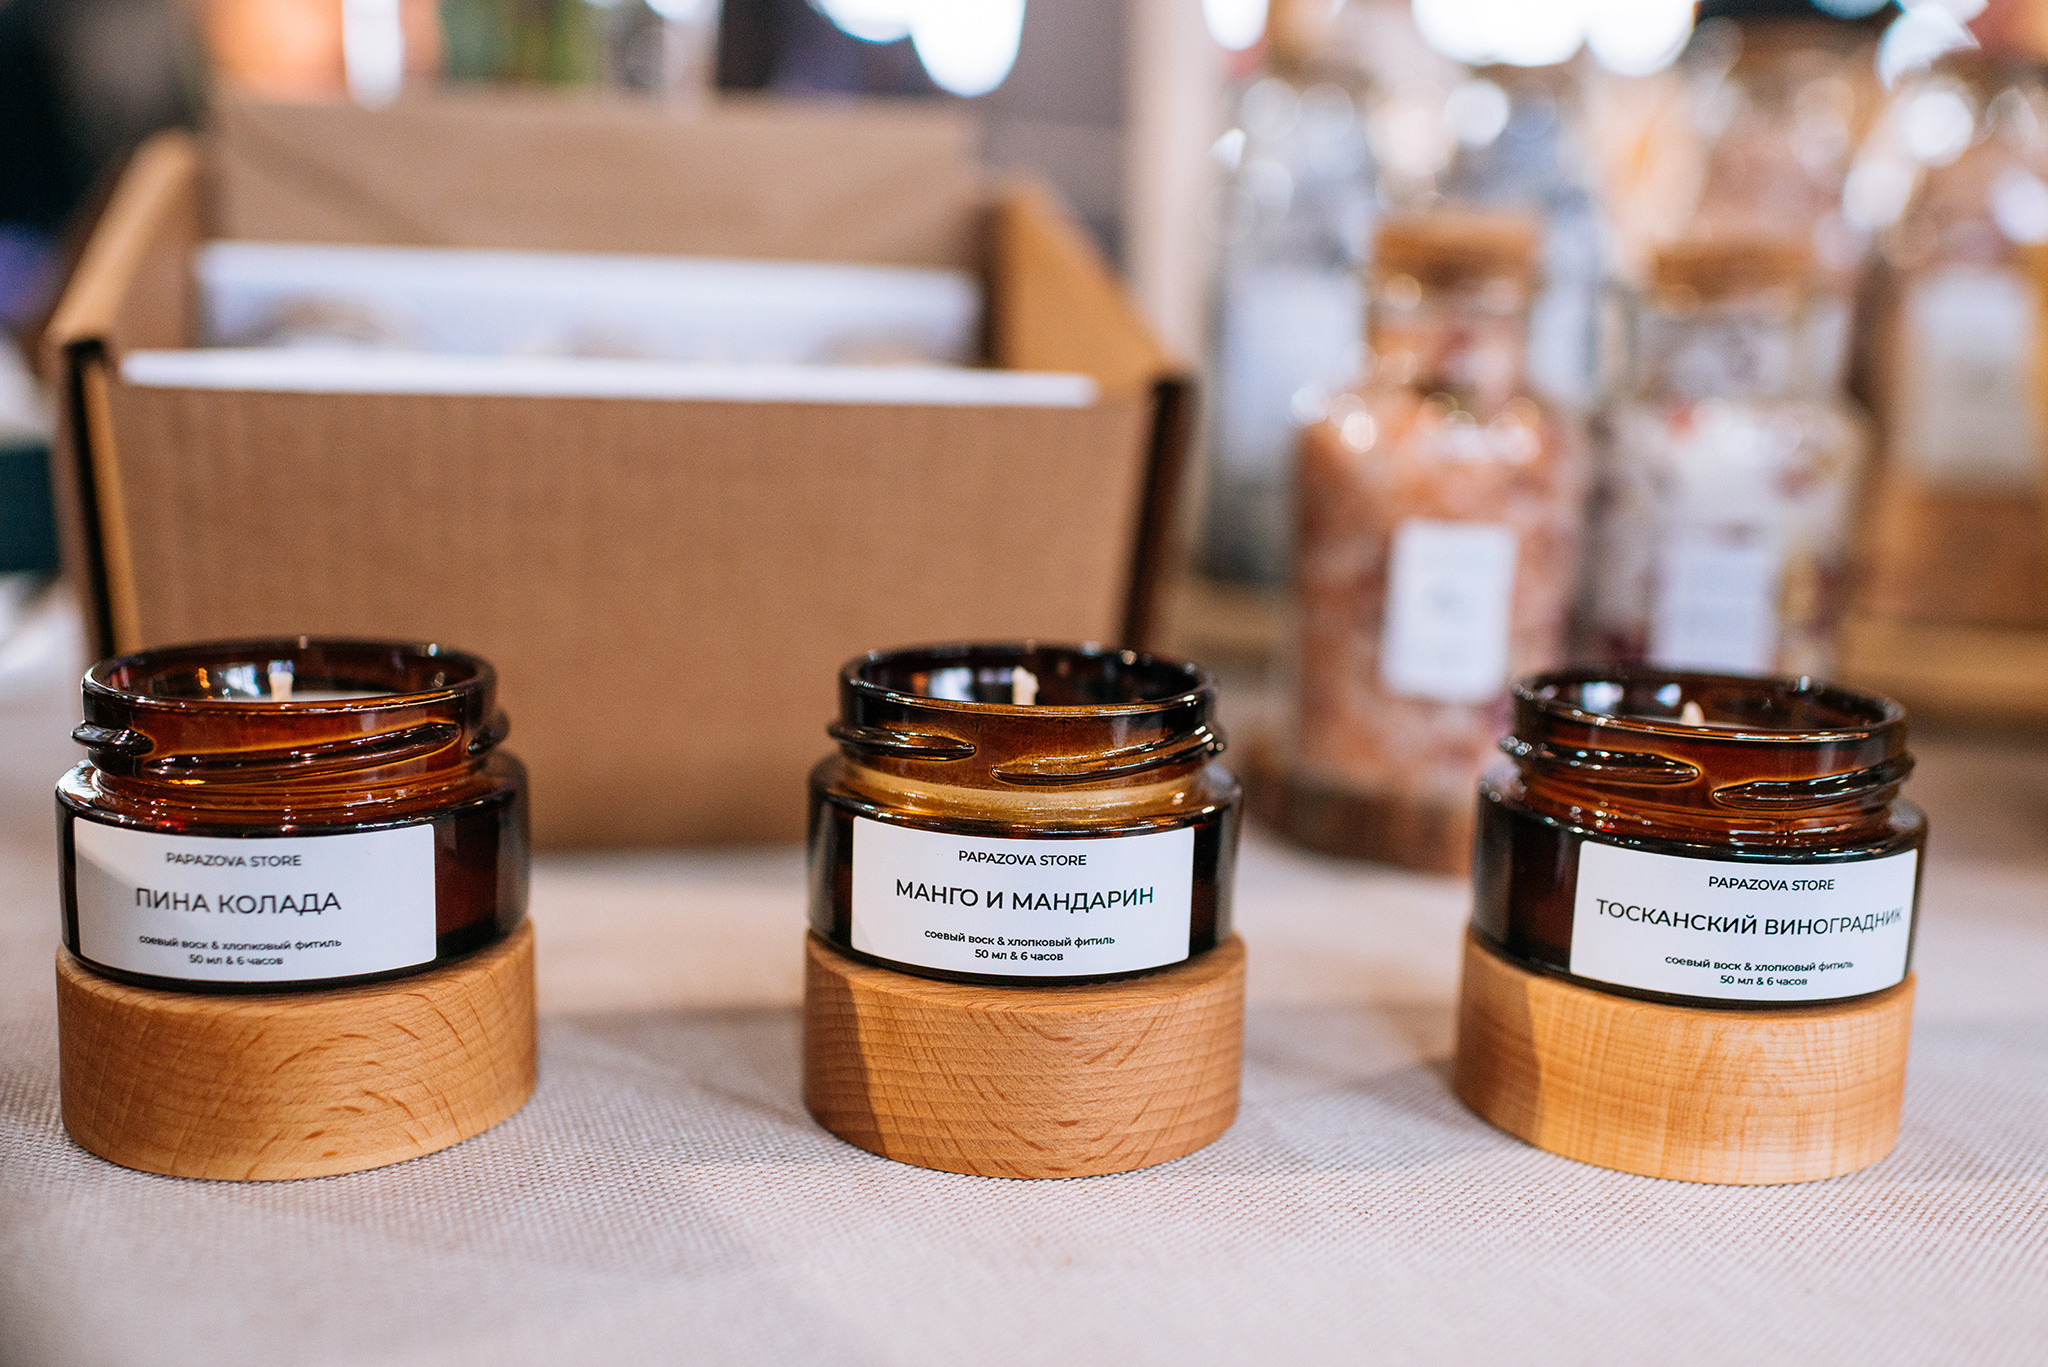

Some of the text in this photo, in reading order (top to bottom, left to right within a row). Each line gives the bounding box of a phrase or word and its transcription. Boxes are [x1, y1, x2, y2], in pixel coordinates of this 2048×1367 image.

[166, 852, 302, 867] PAPAZOVA STORE
[959, 850, 1086, 866] PAPAZOVA STORE
[1709, 876, 1835, 891] PAPAZOVA STORE
[136, 888, 342, 916] ПИНА КОЛАДА
[897, 879, 1153, 914] МАНГО И МАНДАРИН
[1597, 899, 1903, 935] ТОСКАНСКИЙ ВИНОГРАДНИК
[139, 936, 342, 951] соевый воск & хлопковый фитиль
[925, 931, 1115, 948] соевый воск & хлопковый фитиль
[189, 954, 204, 964] 50
[226, 956, 234, 965] &
[236, 956, 245, 965] 6
[975, 949, 989, 958] 50
[992, 952, 1007, 960] мл
[1010, 951, 1018, 960] &
[1020, 952, 1028, 961] 6
[1665, 957, 1853, 972] соевый воск & хлопковый фитиль
[1720, 975, 1734, 984] 50
[1756, 977, 1764, 985] &
[1767, 977, 1773, 985] 6
